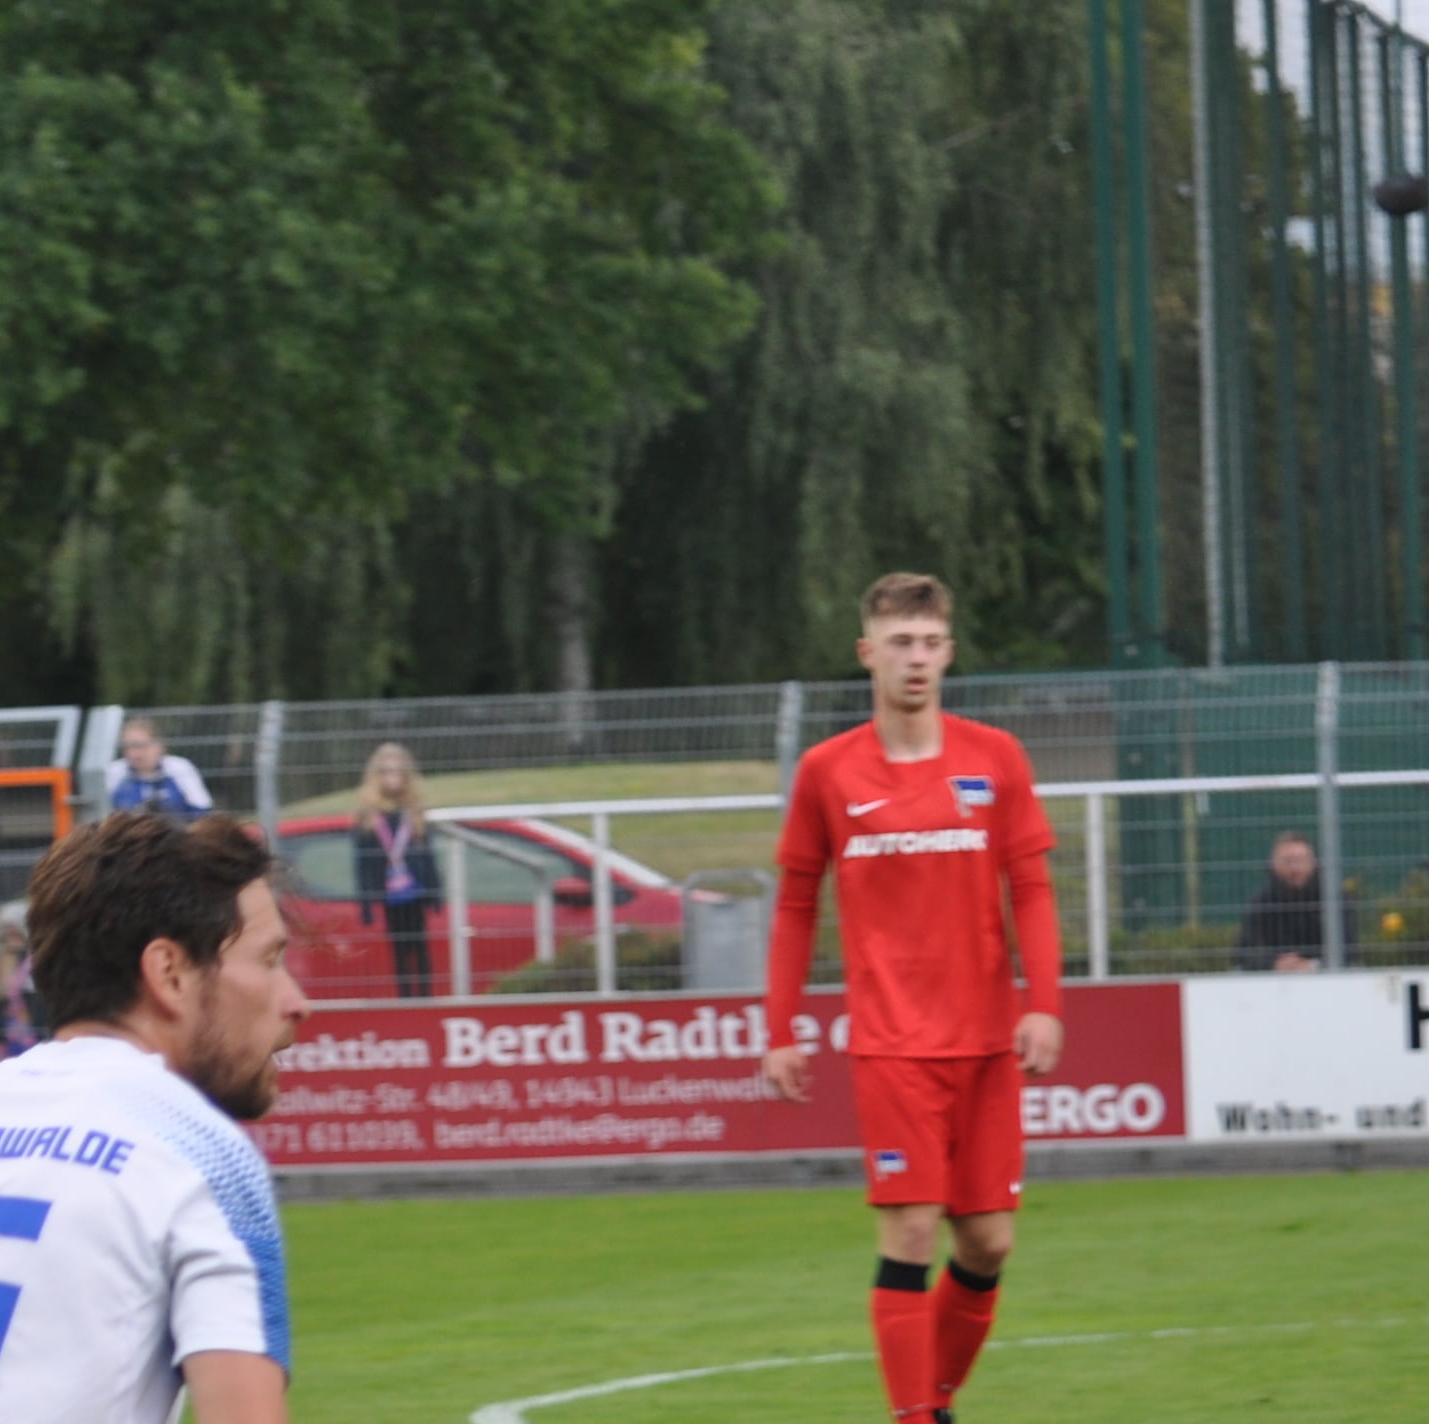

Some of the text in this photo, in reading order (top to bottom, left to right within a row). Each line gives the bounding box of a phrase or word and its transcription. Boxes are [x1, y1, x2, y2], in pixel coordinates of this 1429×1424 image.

[272, 1031, 431, 1072] rektion
[442, 1010, 587, 1067] Berd
[618, 1071, 781, 1105] Luckenwald
[1021, 1083, 1167, 1134] ERGO
[1216, 1096, 1425, 1133] Wohn- und
